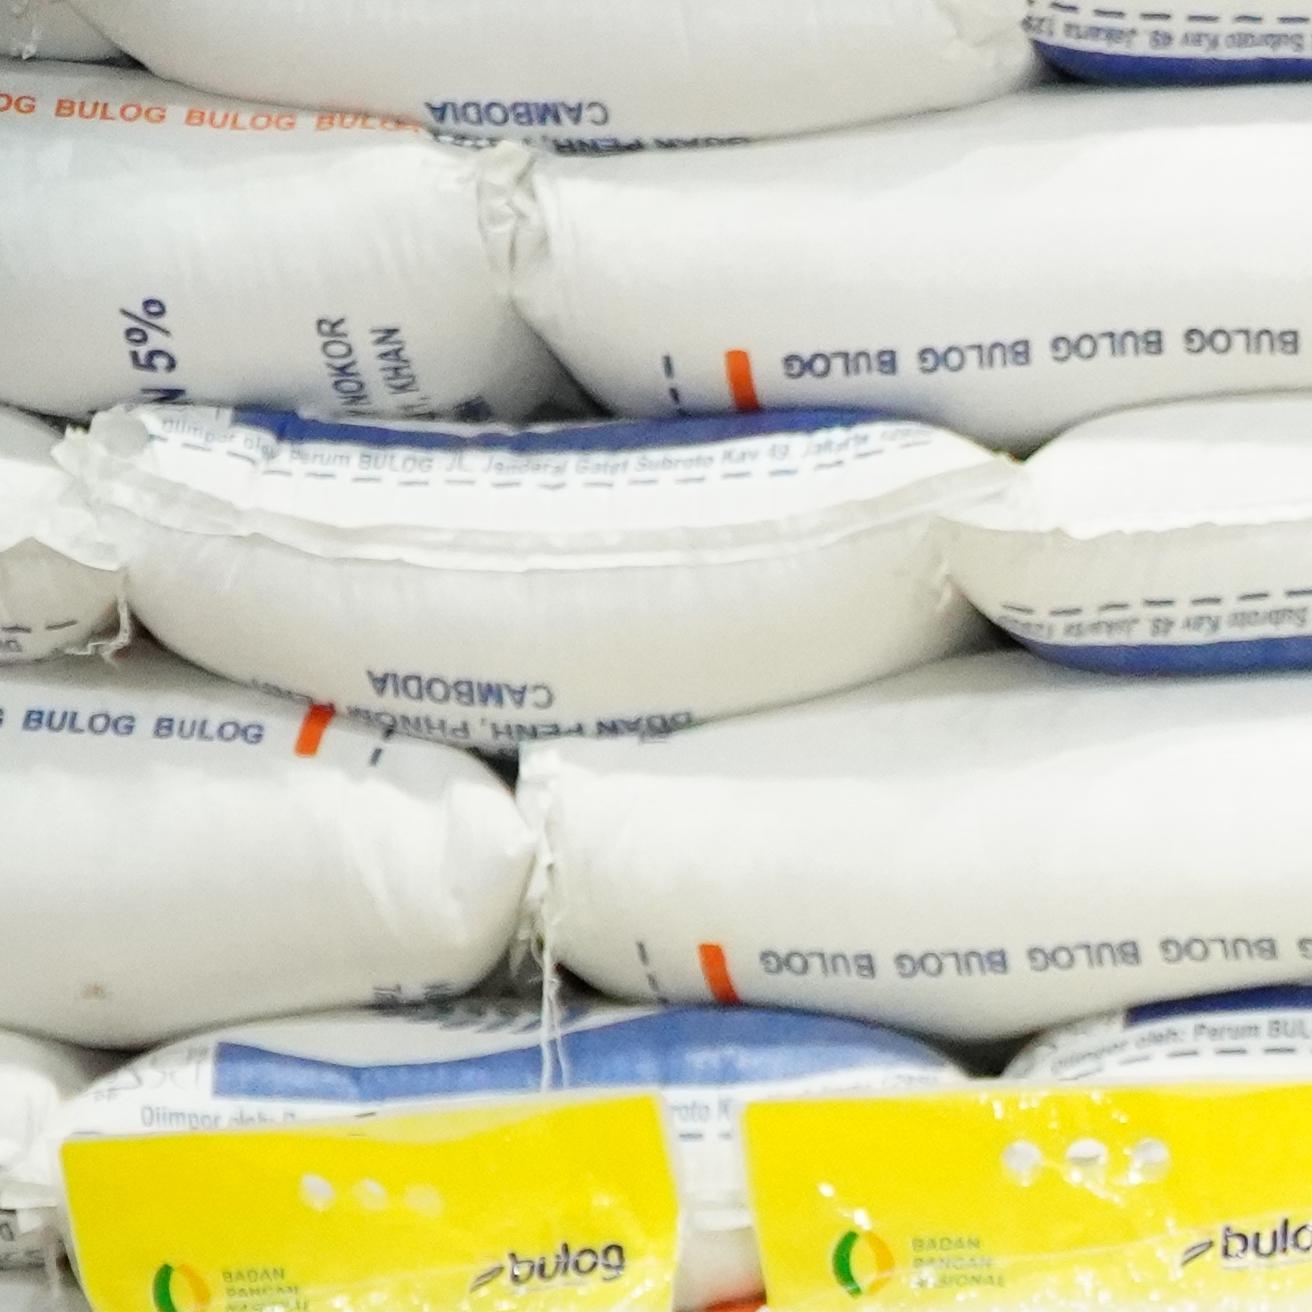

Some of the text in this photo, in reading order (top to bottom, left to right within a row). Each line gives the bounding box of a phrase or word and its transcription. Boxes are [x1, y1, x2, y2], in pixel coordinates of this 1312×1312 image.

[54, 99, 169, 124] BULOG
[184, 108, 297, 133] BULOG
[424, 101, 609, 126] CAMBODIA
[118, 298, 177, 374] 5%
[781, 348, 896, 379] BULOG
[917, 340, 1031, 375] BULOG
[1049, 329, 1163, 363] BULOG
[1183, 328, 1299, 356] BULOG
[367, 327, 420, 394] KHAN
[364, 670, 554, 710] CAMBODIA
[22, 708, 265, 744] BULOG BULOG
[759, 949, 875, 979] BULOG
[893, 948, 1008, 979] BULOG
[1026, 941, 1142, 972] BULOG
[1160, 938, 1280, 964] BULOG
[507, 1241, 626, 1284] bulog
[912, 1237, 981, 1252] BADAN
[222, 1266, 286, 1284] BADAN
